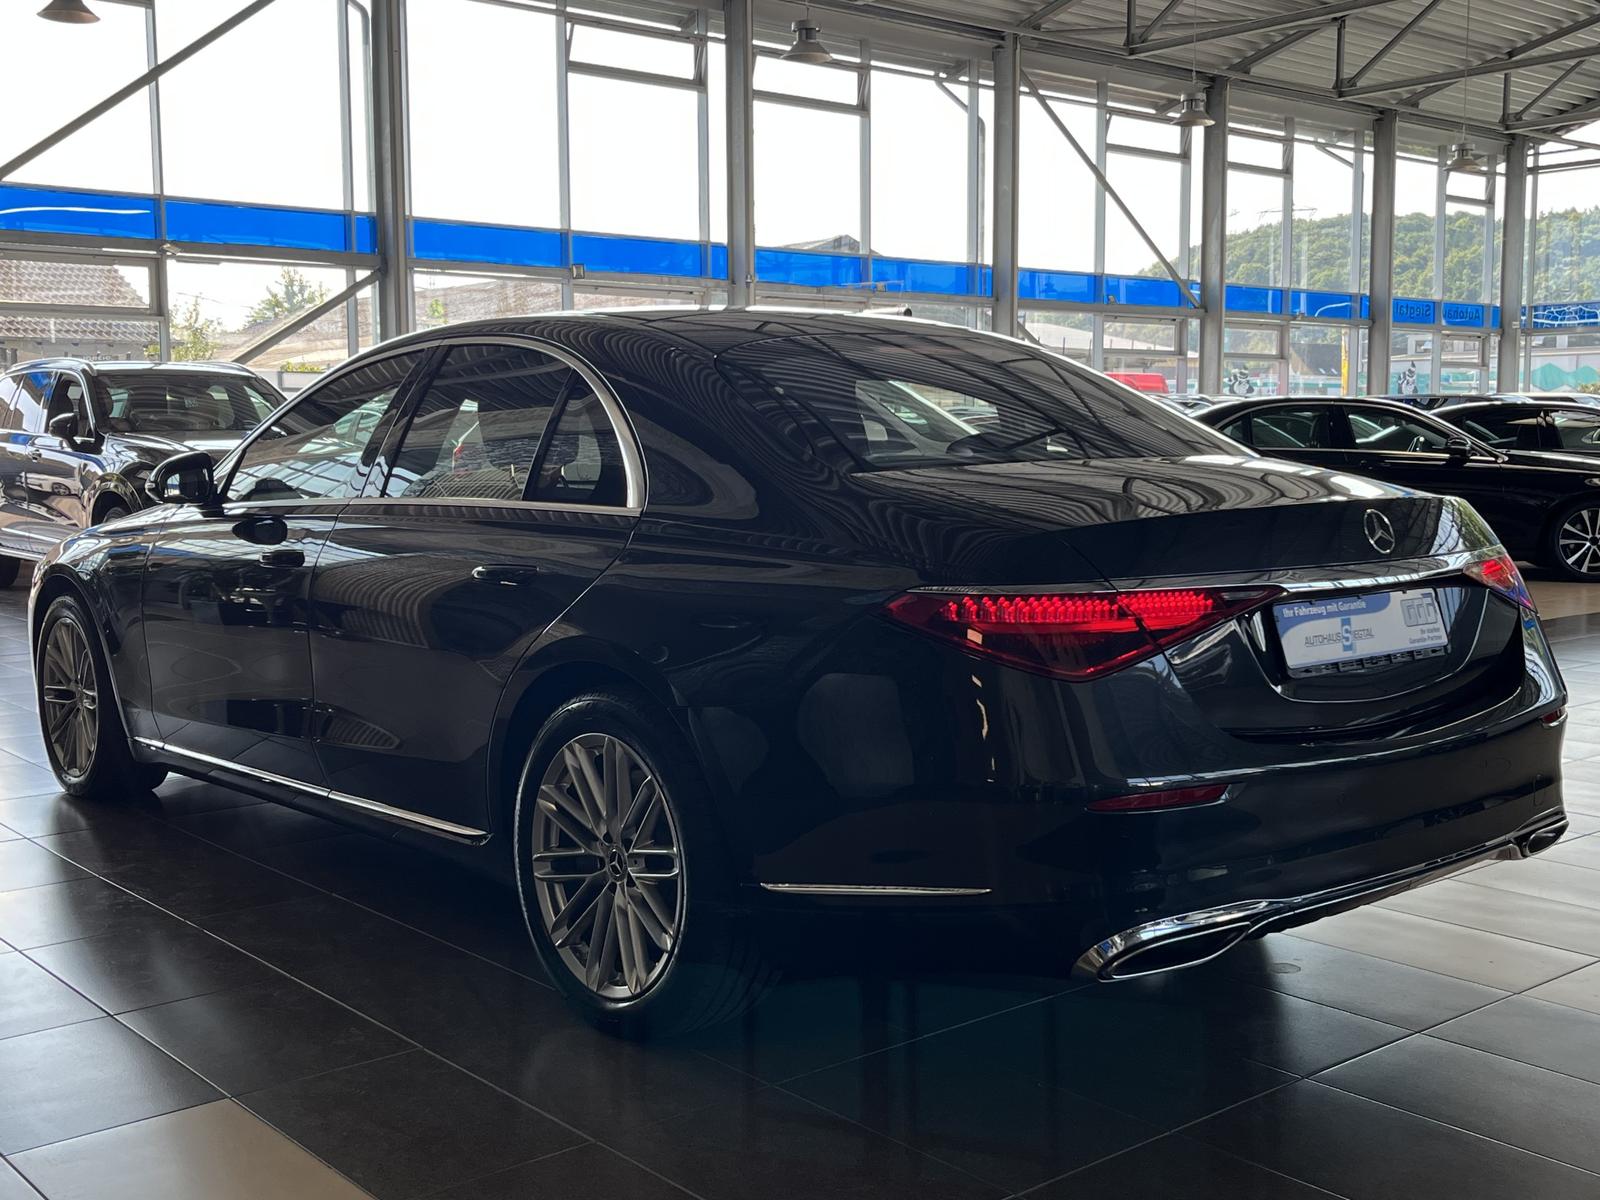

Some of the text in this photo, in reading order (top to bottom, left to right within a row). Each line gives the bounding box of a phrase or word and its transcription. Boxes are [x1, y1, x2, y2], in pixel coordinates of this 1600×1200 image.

[1282, 600, 1366, 618] Ihr Fahrzeug mit Garantie
[1304, 632, 1342, 646] AUTOHAUS
